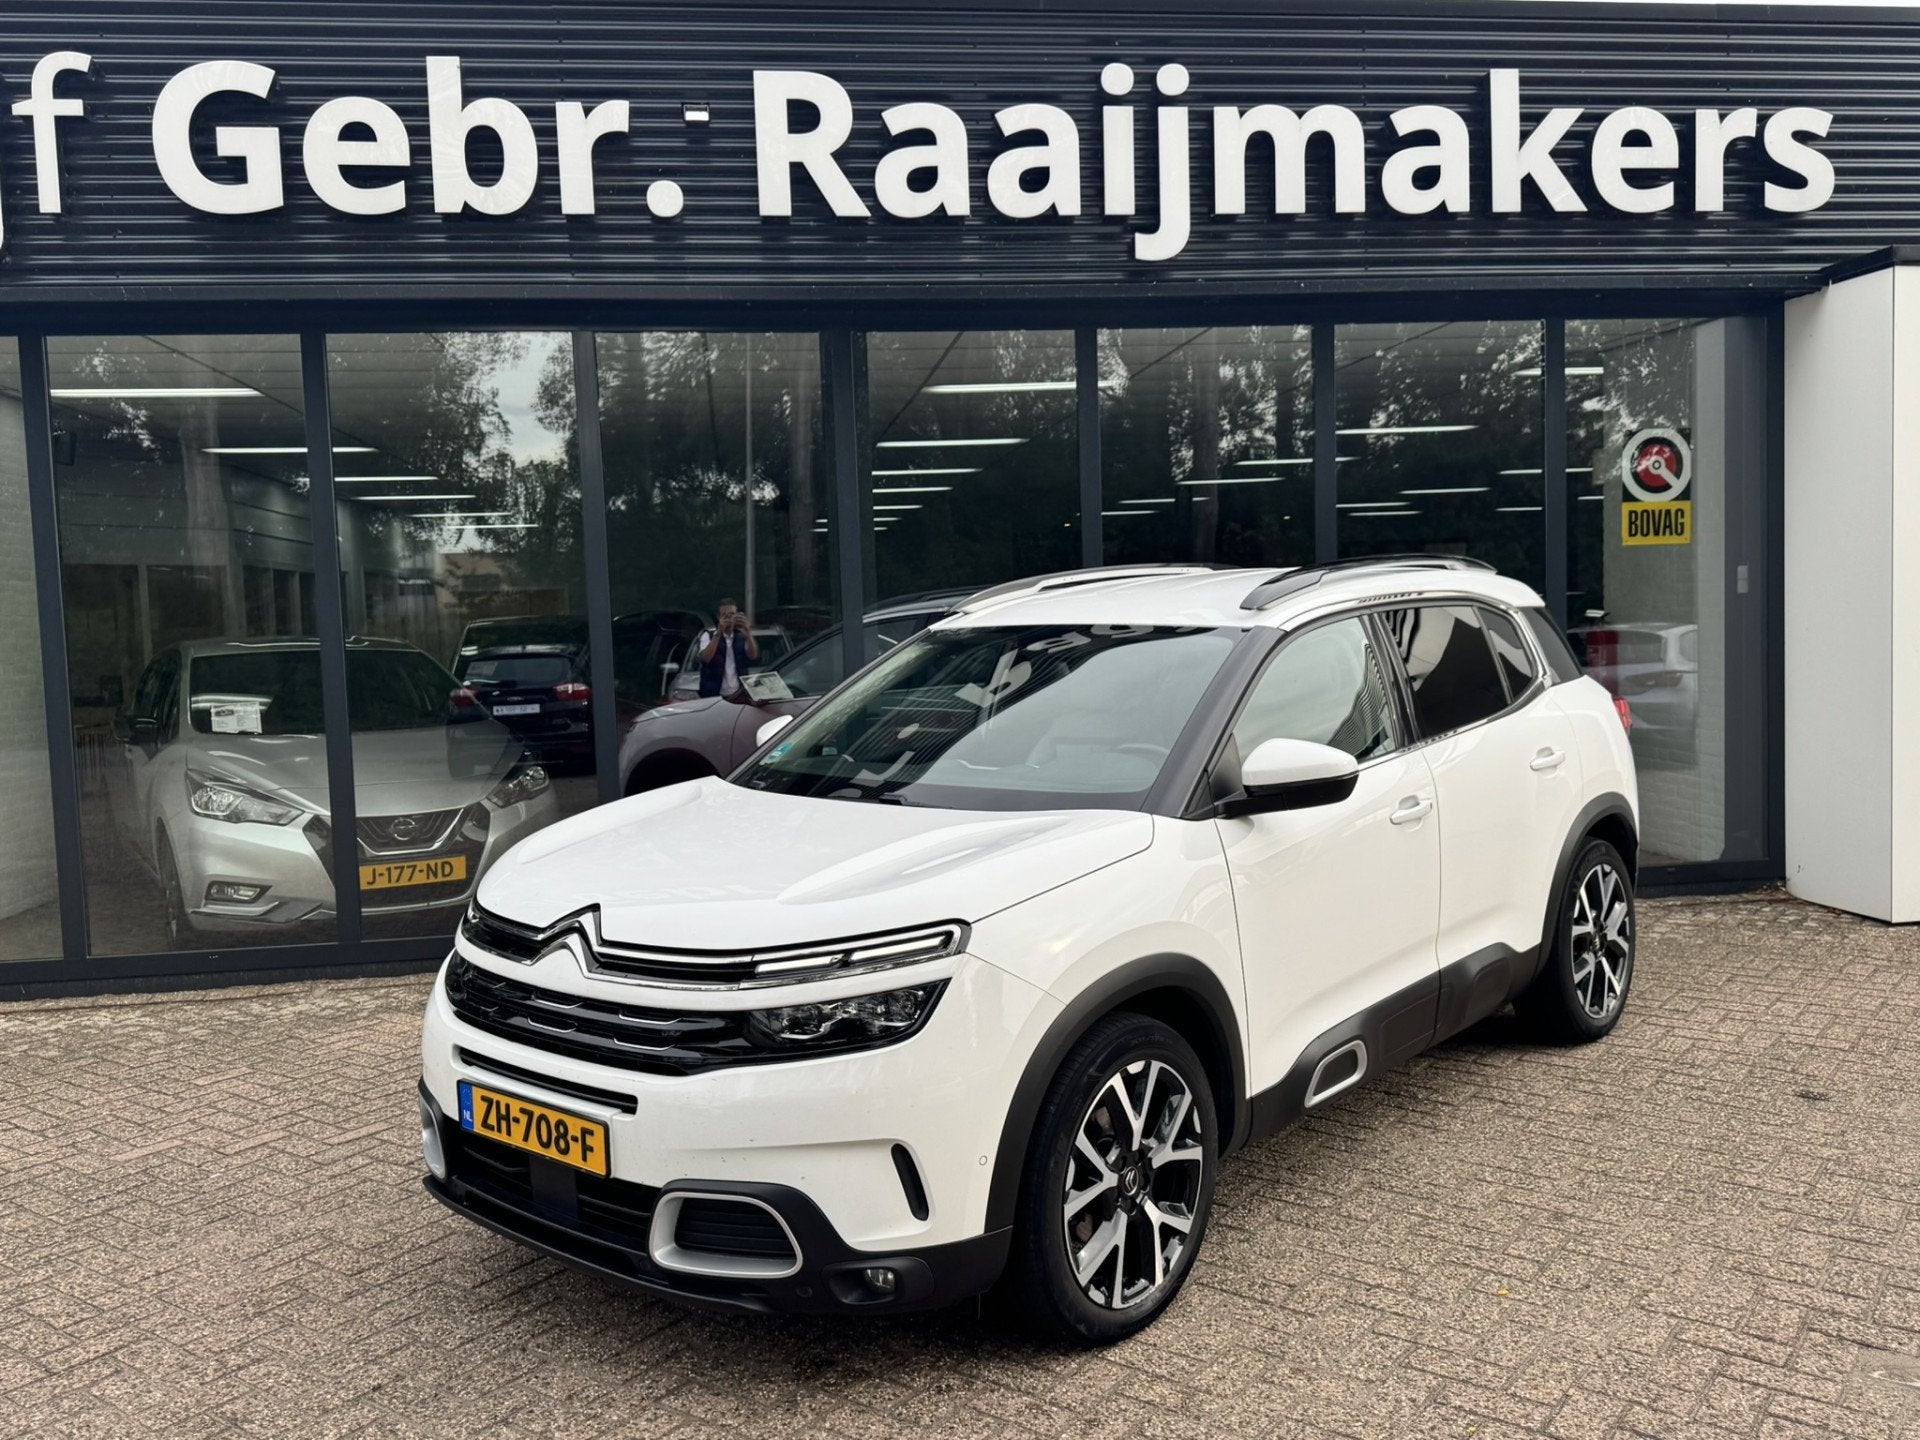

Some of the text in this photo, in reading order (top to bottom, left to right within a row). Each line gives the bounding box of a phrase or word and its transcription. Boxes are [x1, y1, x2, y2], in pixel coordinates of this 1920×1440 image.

[152, 56, 684, 218] Gebr.
[753, 62, 1835, 261] Raaijmakers
[1628, 508, 1684, 537] BOVAG
[366, 861, 454, 886] J-177-ND
[463, 1095, 595, 1163] NL ZH-708-F
